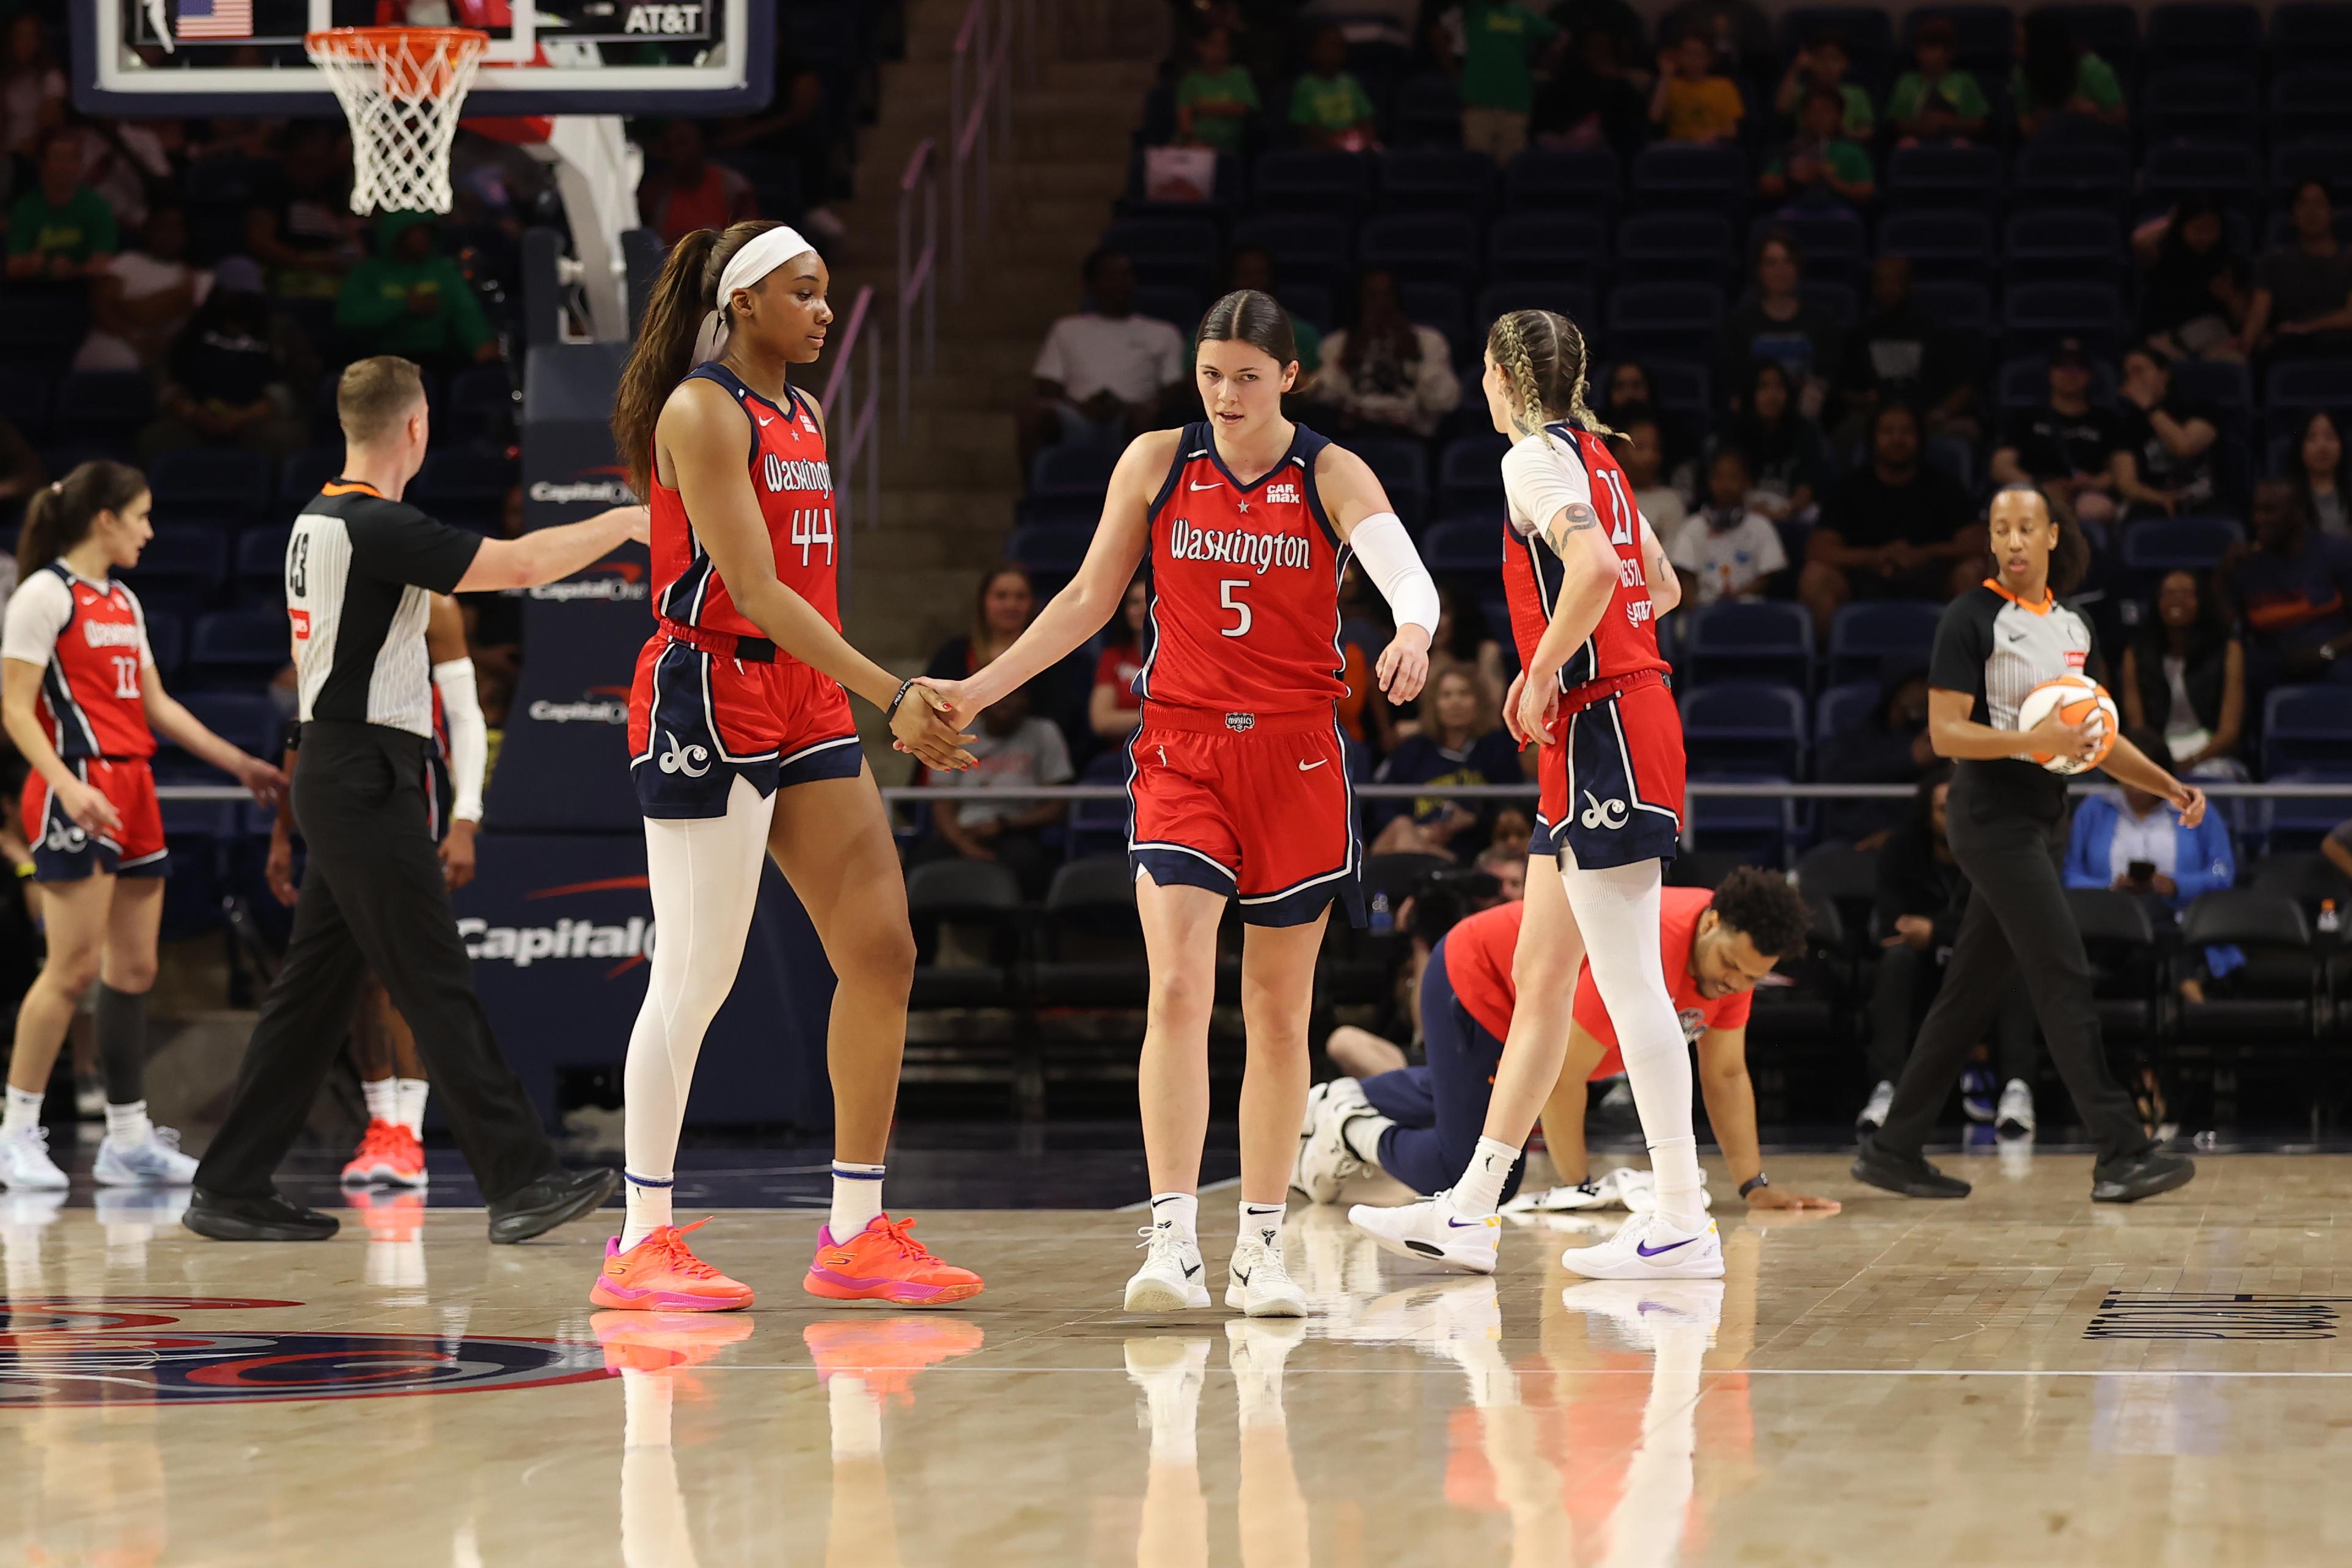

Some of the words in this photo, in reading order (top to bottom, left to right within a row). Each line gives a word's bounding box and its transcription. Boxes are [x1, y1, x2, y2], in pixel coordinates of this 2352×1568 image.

[625, 4, 702, 34] AT&T
[764, 453, 834, 499] Washingt
[1266, 483, 1294, 494] CAR
[1595, 469, 1634, 546] 21
[791, 508, 834, 566] 44
[1171, 519, 1310, 574] Washington
[1220, 579, 1252, 637] 5
[456, 917, 656, 967] Capital
